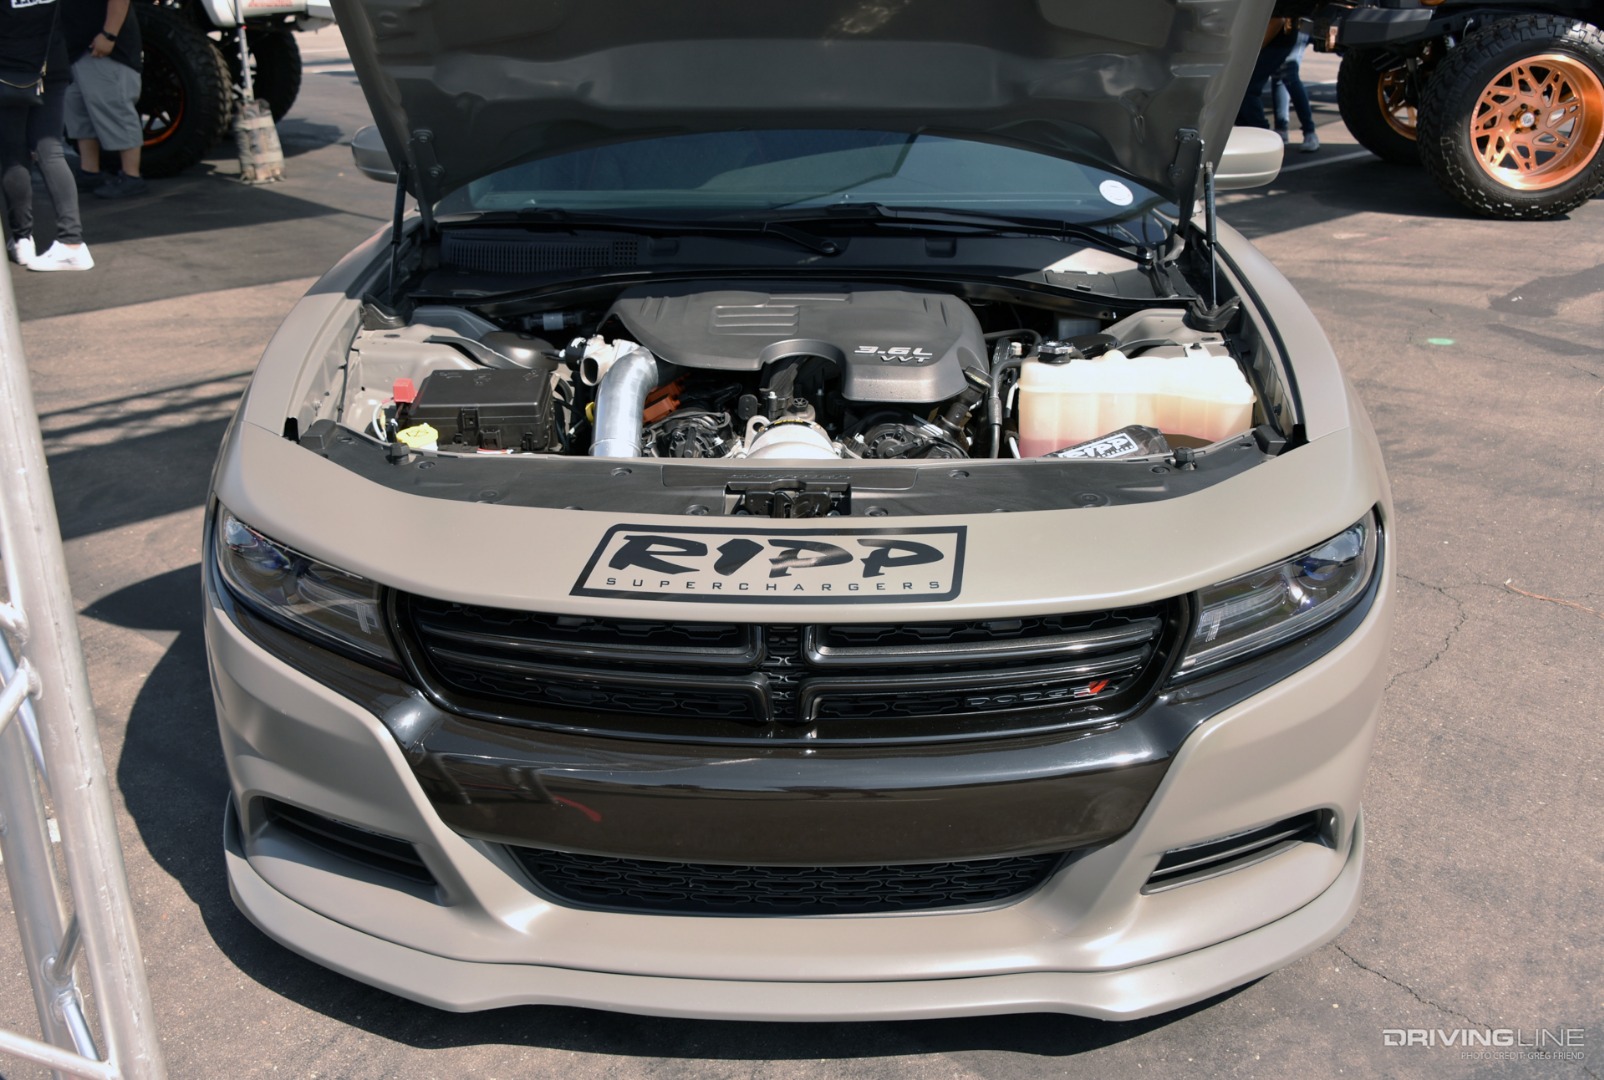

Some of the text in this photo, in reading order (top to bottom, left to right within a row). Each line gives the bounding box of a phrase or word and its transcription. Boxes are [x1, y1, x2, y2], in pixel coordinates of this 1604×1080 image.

[854, 345, 933, 356] 3.6L
[881, 355, 930, 363] VVT
[608, 535, 944, 578] RIPP
[606, 577, 940, 591] SUPERCHARGERS
[966, 686, 1097, 705] DODGE
